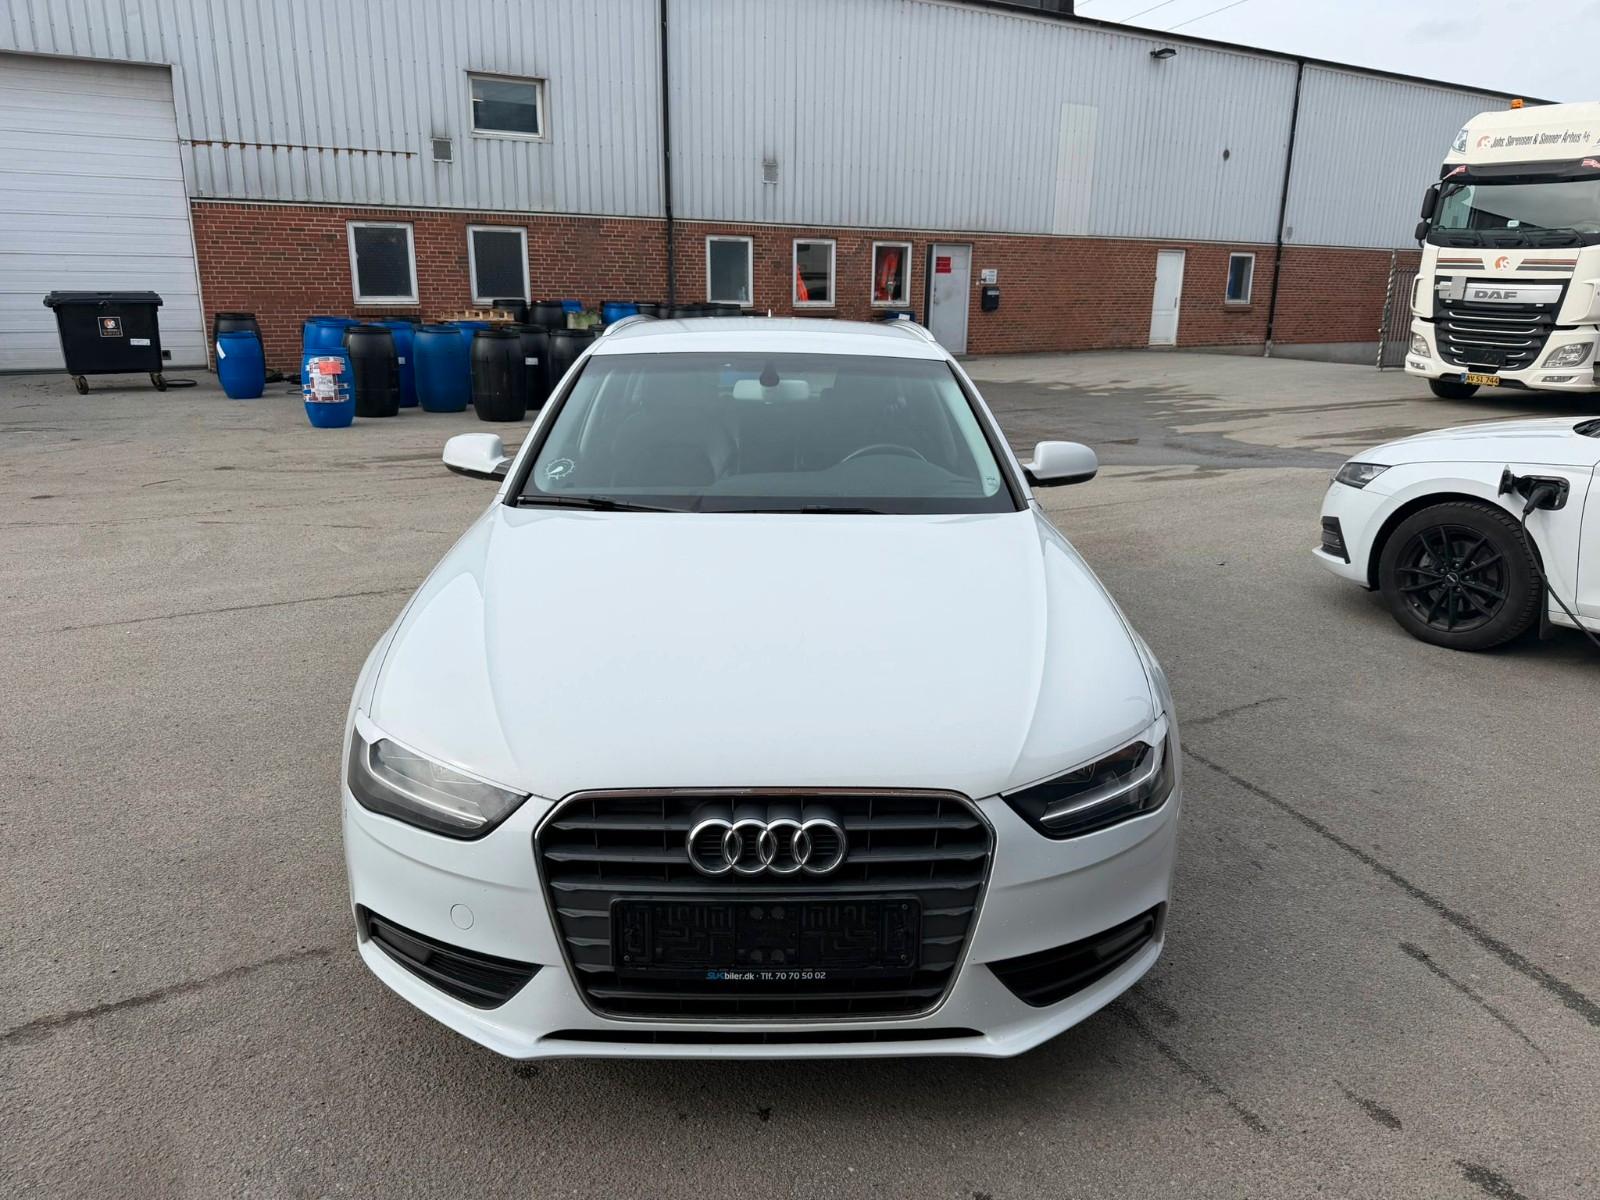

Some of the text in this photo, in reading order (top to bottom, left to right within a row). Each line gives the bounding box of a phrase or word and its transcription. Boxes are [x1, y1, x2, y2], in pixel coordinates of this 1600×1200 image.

[1533, 133, 1539, 145] &
[1474, 290, 1518, 299] DAF
[760, 972, 774, 980] Tlf.
[775, 972, 787, 980] 70
[788, 972, 800, 980] 70
[801, 972, 813, 980] 50
[814, 971, 827, 980] 02
